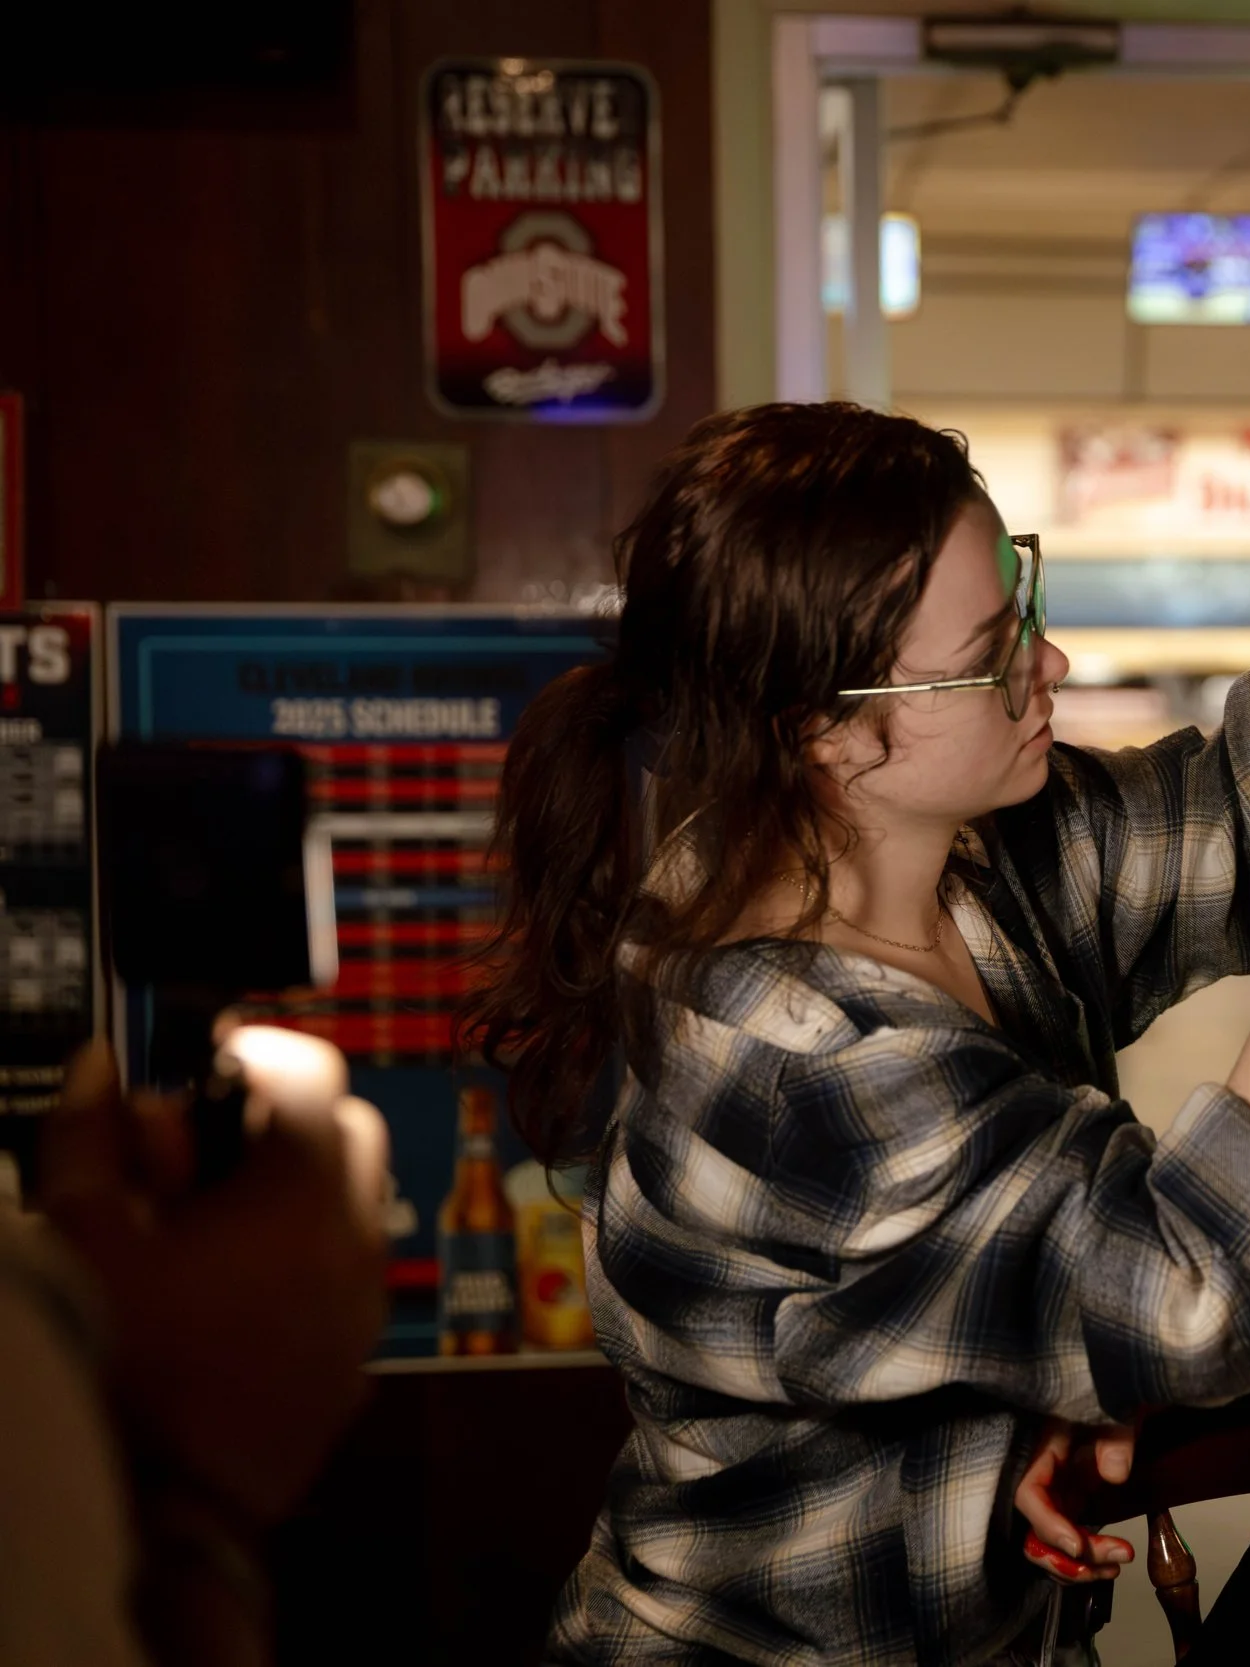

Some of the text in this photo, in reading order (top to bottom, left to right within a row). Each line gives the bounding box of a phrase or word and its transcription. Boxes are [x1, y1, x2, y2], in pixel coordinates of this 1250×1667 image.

[442, 73, 641, 140] RESERVE
[442, 145, 642, 203] PARKING
[270, 697, 501, 741] 2025 SCHEDULE
